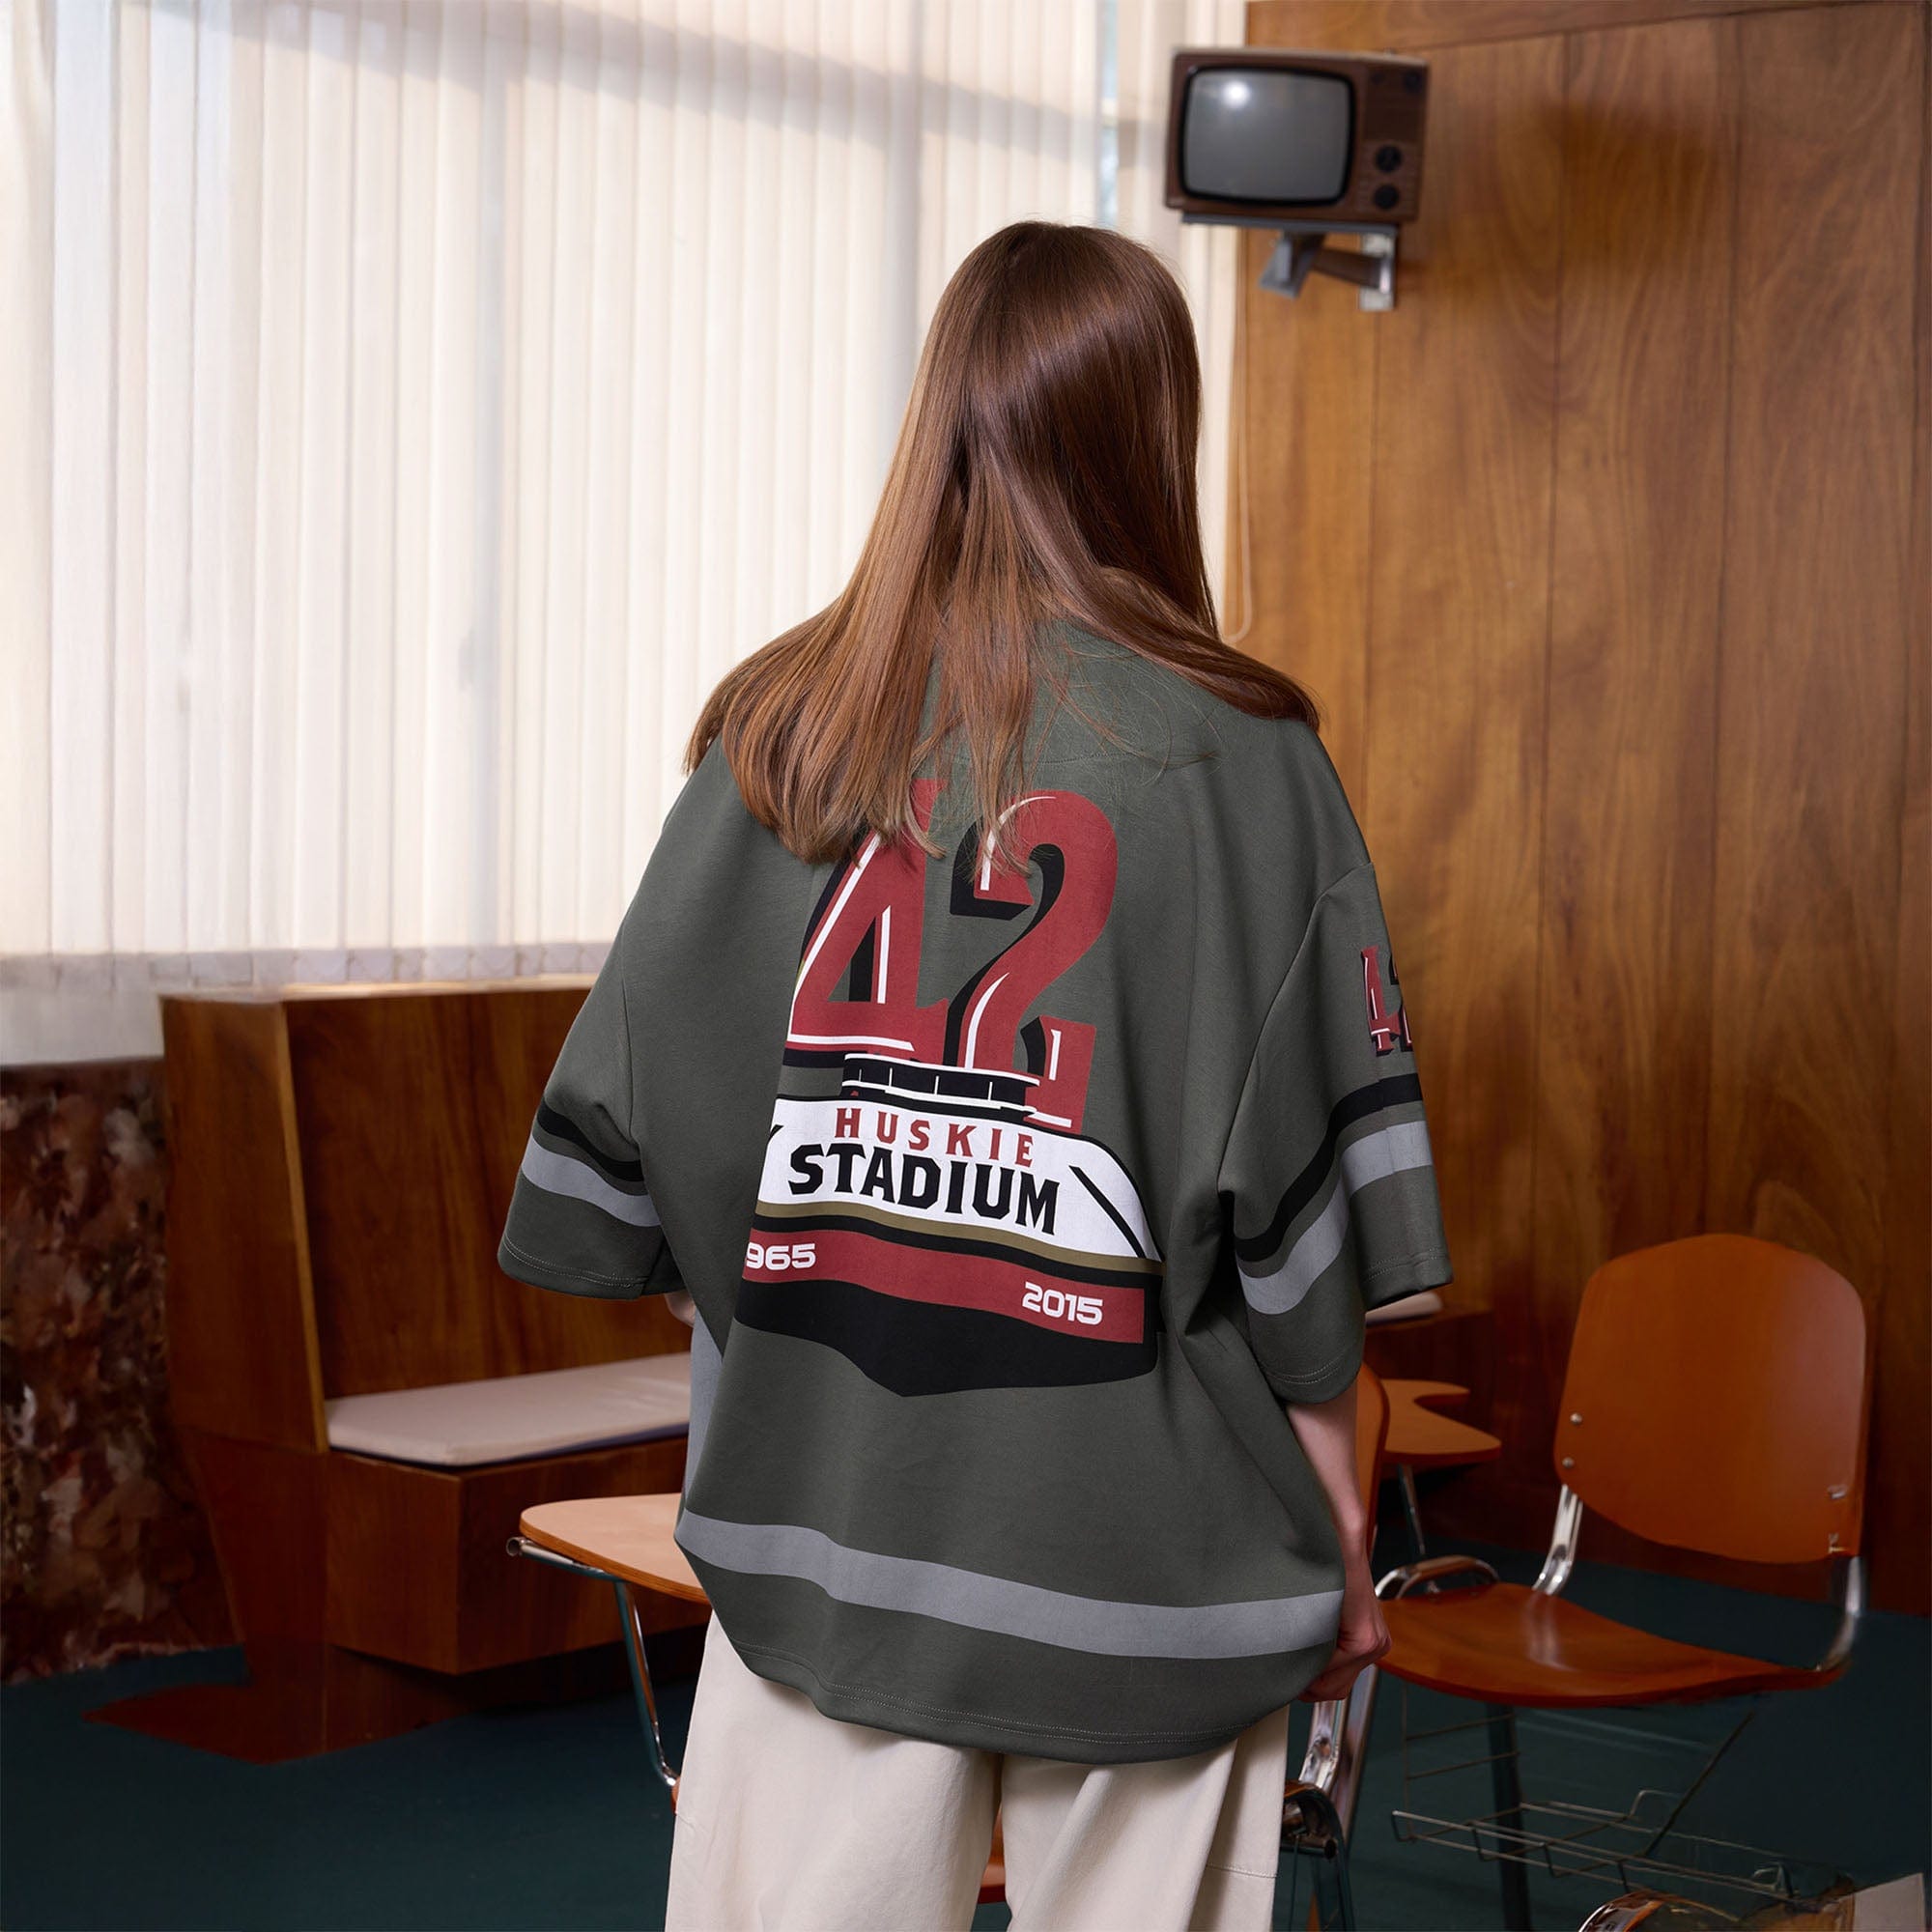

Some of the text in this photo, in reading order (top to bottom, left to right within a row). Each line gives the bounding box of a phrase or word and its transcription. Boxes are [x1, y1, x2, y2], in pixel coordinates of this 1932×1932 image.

[782, 779, 1118, 1134] 42
[1361, 945, 1412, 1057] 4
[835, 1108, 1033, 1167] HUSKIE
[788, 1143, 1060, 1235] STADIUM
[1022, 1281, 1103, 1325] 2015
